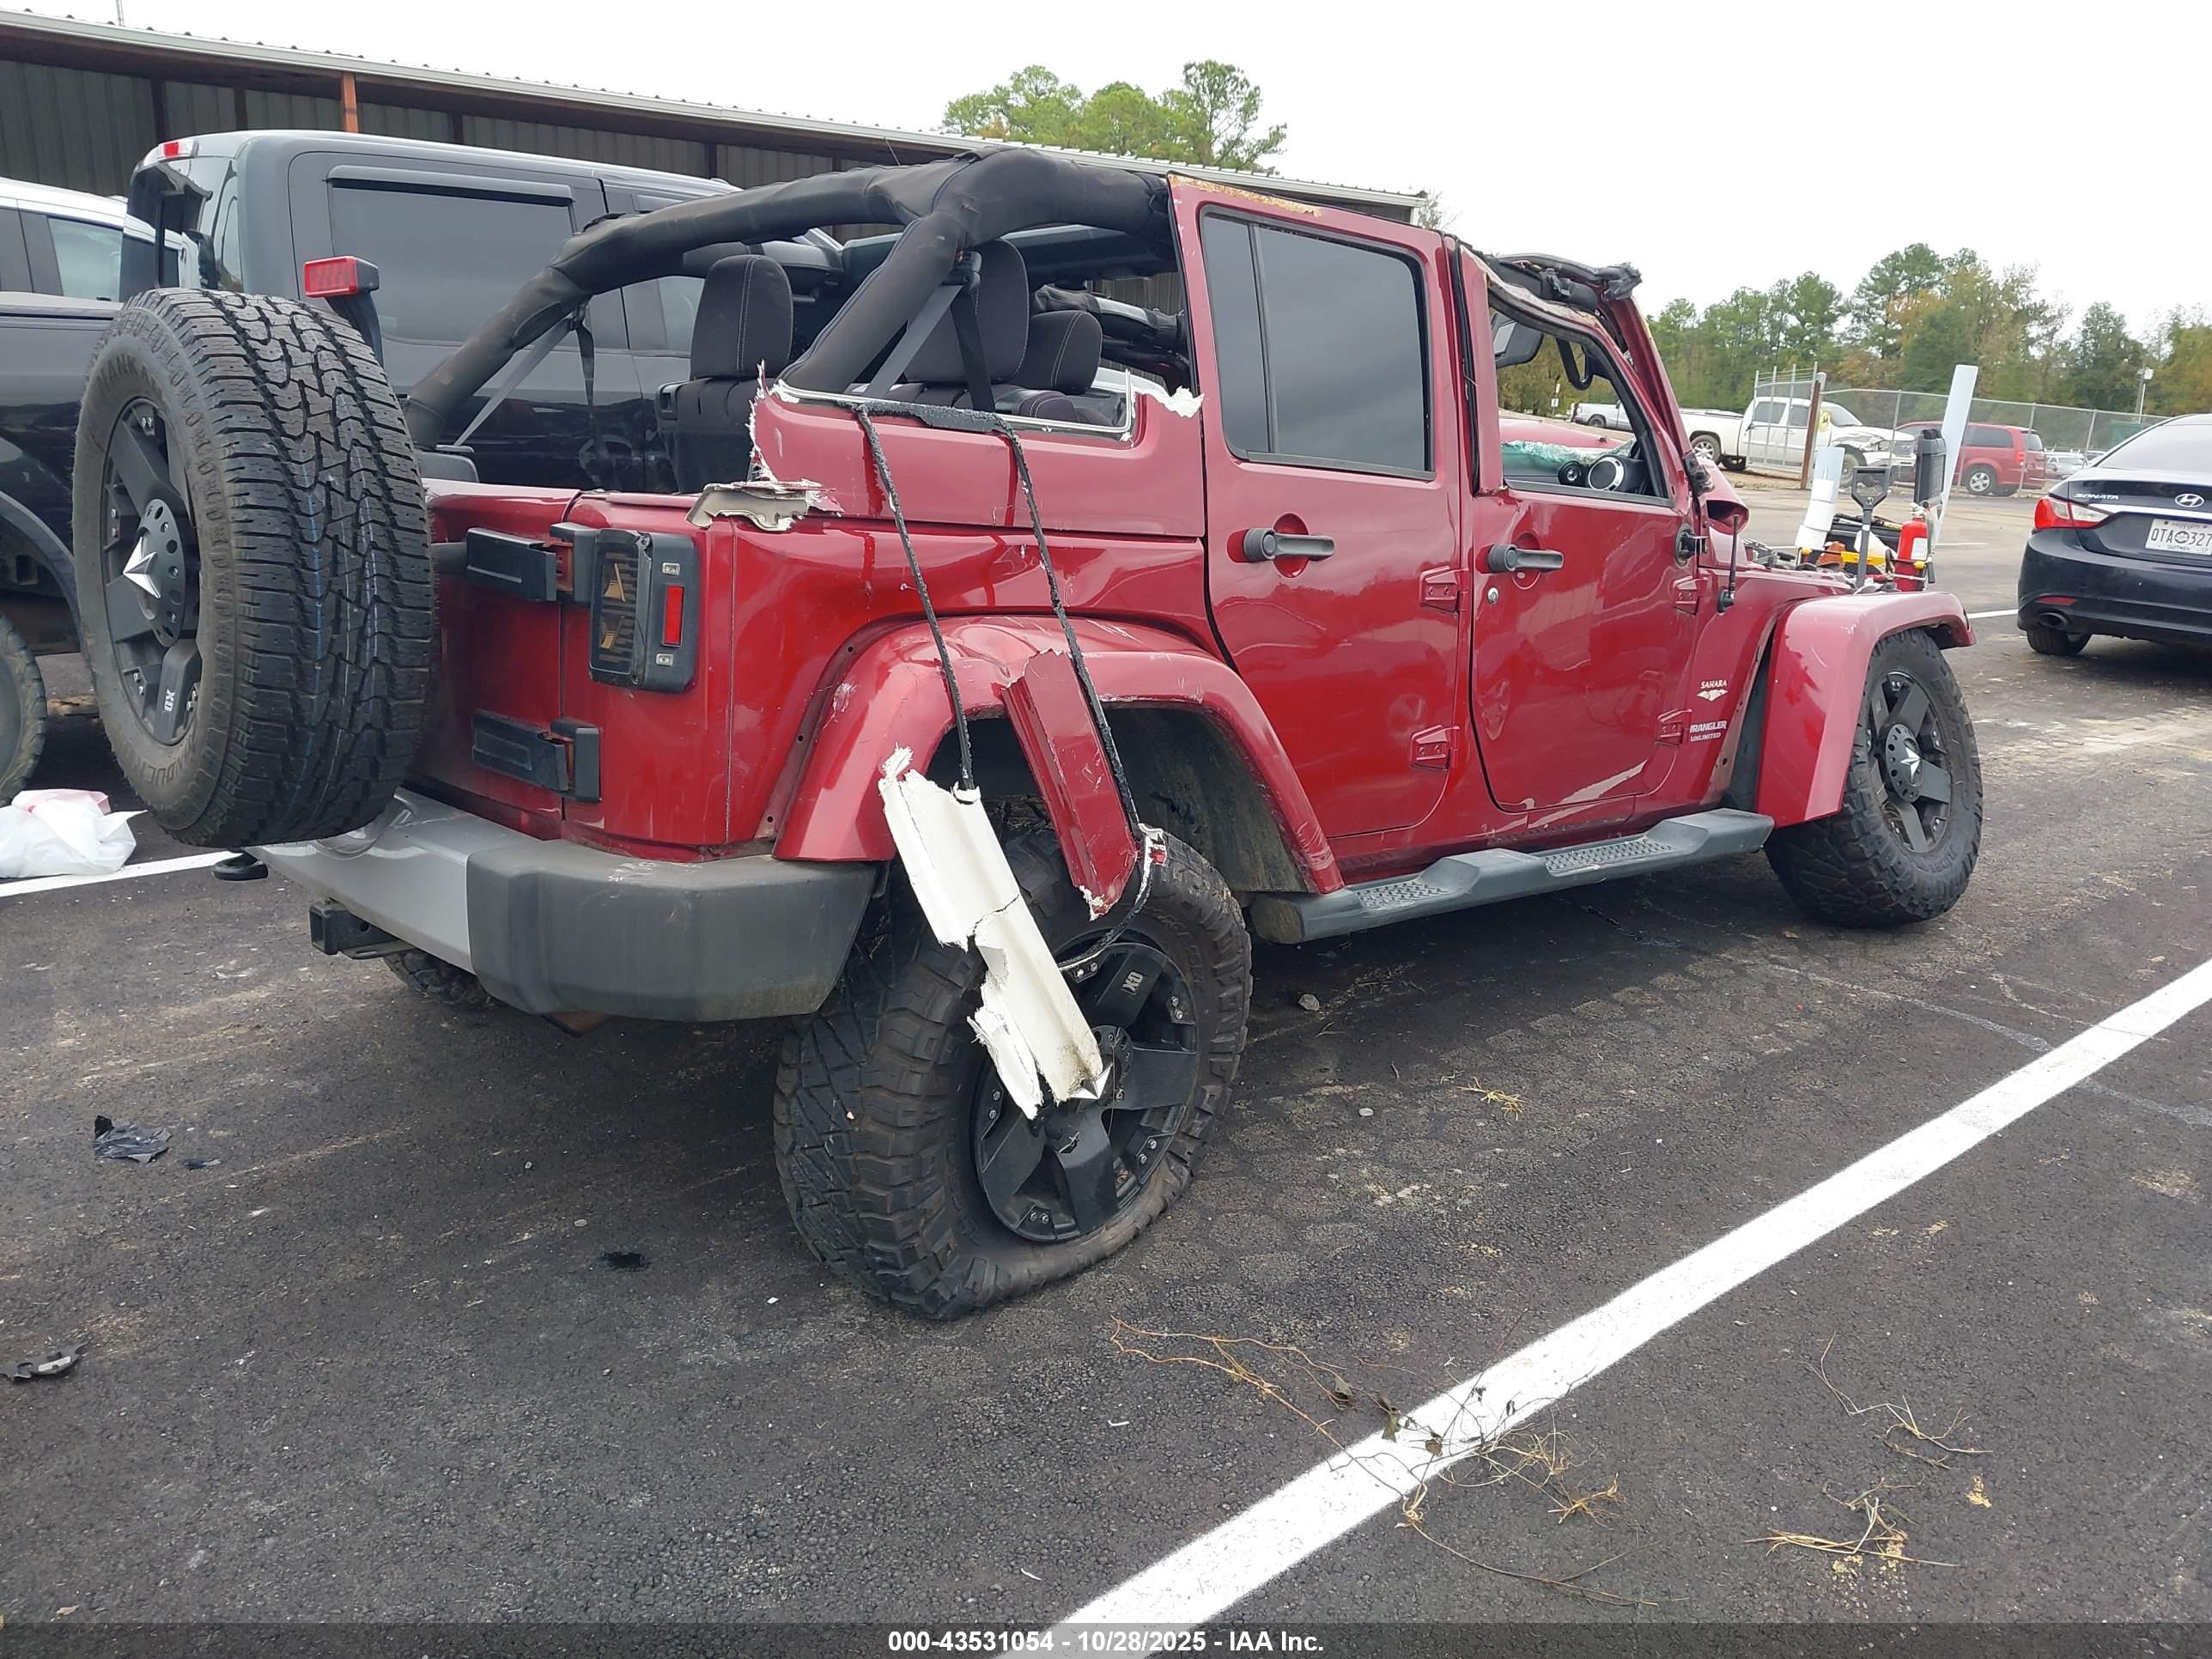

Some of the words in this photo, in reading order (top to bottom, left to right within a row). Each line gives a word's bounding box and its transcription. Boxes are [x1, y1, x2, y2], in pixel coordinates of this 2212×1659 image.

[1701, 679, 1727, 689] SAHARA
[164, 689, 175, 712] XD
[1691, 732, 1721, 742] UNLIMITED
